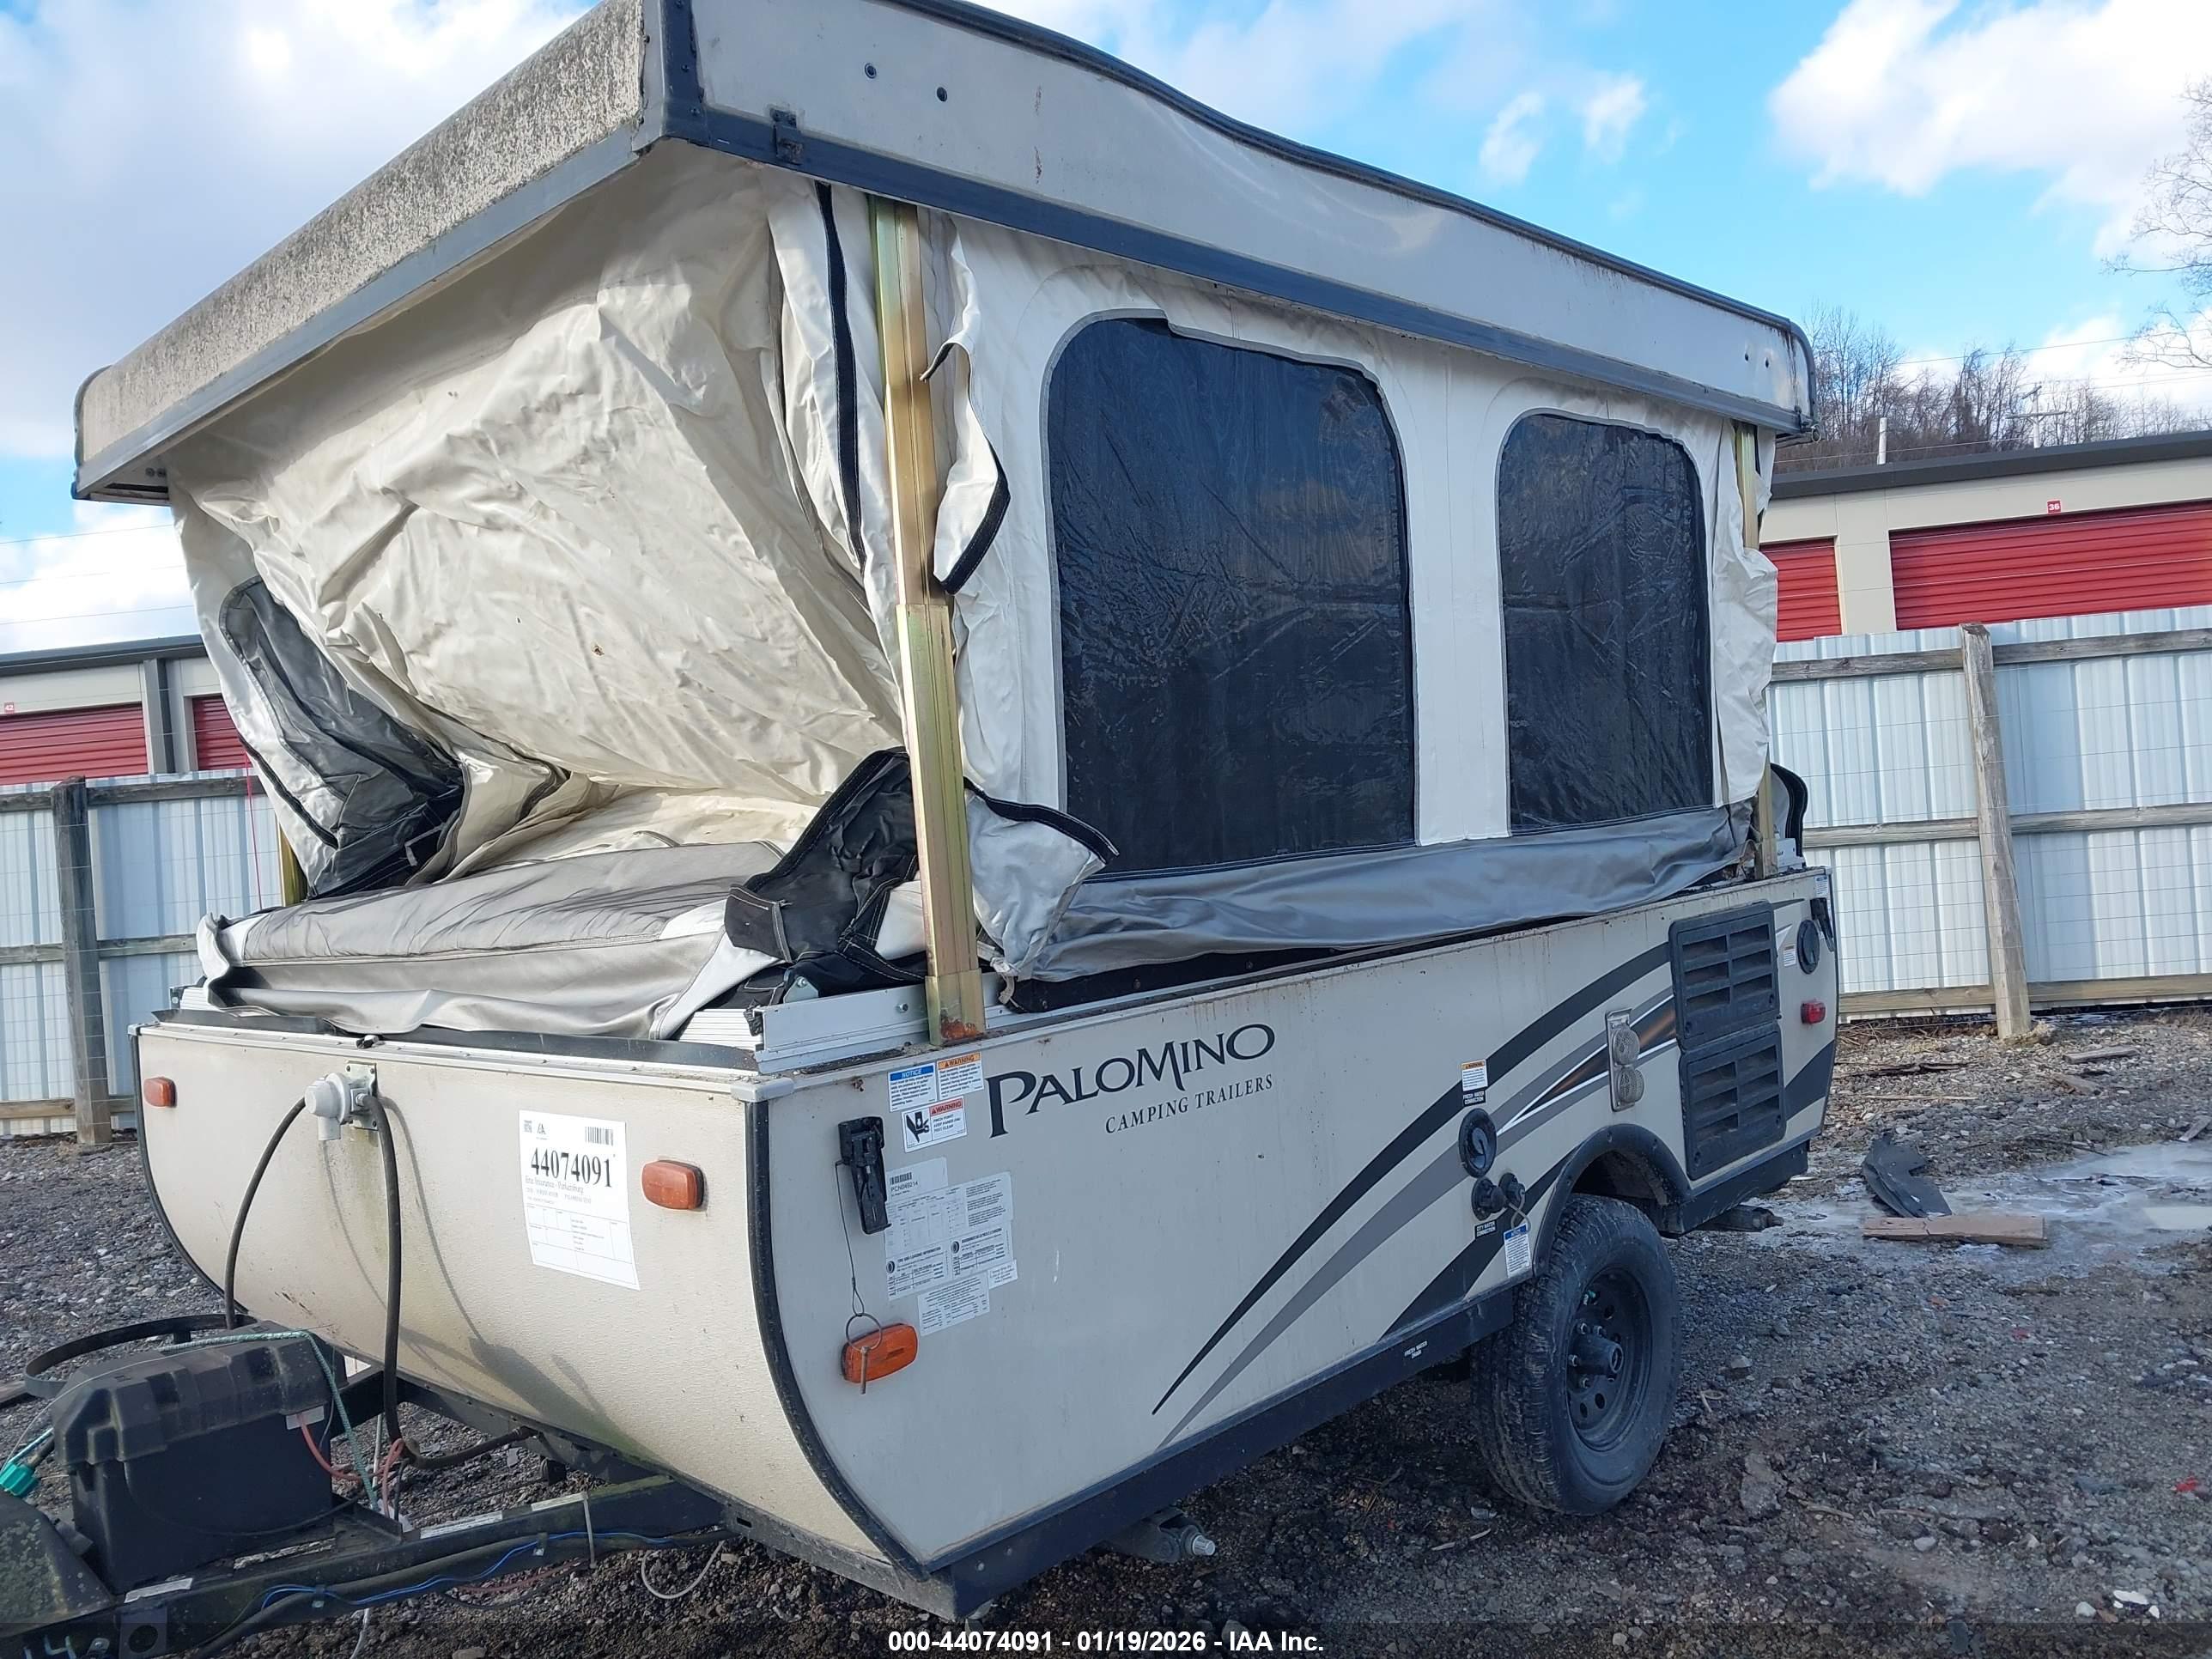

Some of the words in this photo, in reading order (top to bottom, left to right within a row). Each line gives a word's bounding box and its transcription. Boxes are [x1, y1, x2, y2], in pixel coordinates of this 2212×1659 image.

[949, 1054, 975, 1066] WARNING
[902, 1068, 922, 1079] NOTICE
[984, 1023, 1275, 1139] PALOMINO
[936, 1101, 962, 1113] WARNING
[1105, 1097, 1188, 1133] CAMPING
[1194, 1074, 1273, 1110] TRAILERS
[531, 1147, 612, 1188] 44074091
